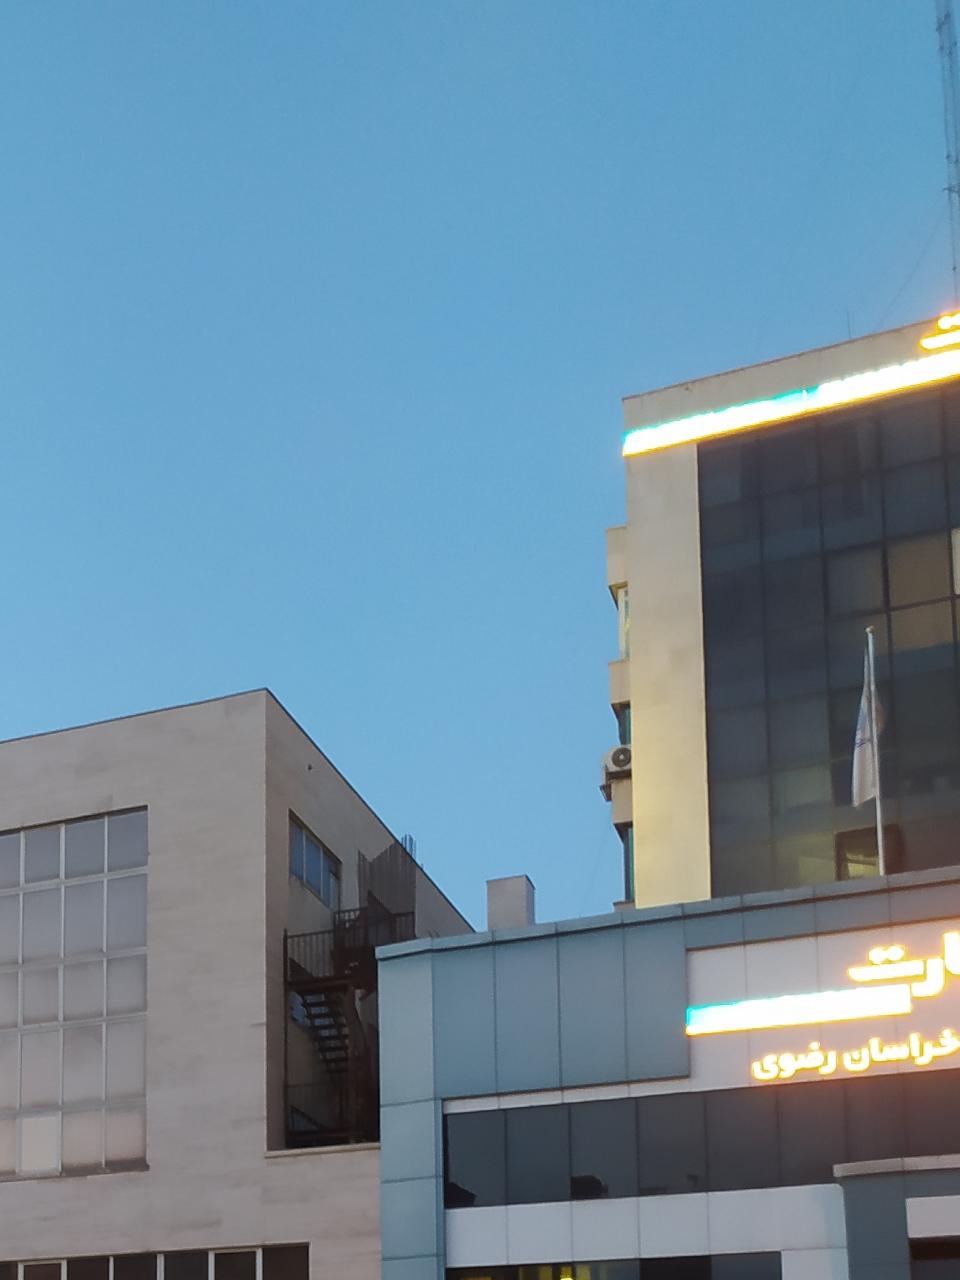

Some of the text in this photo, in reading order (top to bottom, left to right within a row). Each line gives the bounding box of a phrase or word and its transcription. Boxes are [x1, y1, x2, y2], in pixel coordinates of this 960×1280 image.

[847, 931, 960, 998] ارت
[751, 1028, 960, 1081] خراسان رضوی
